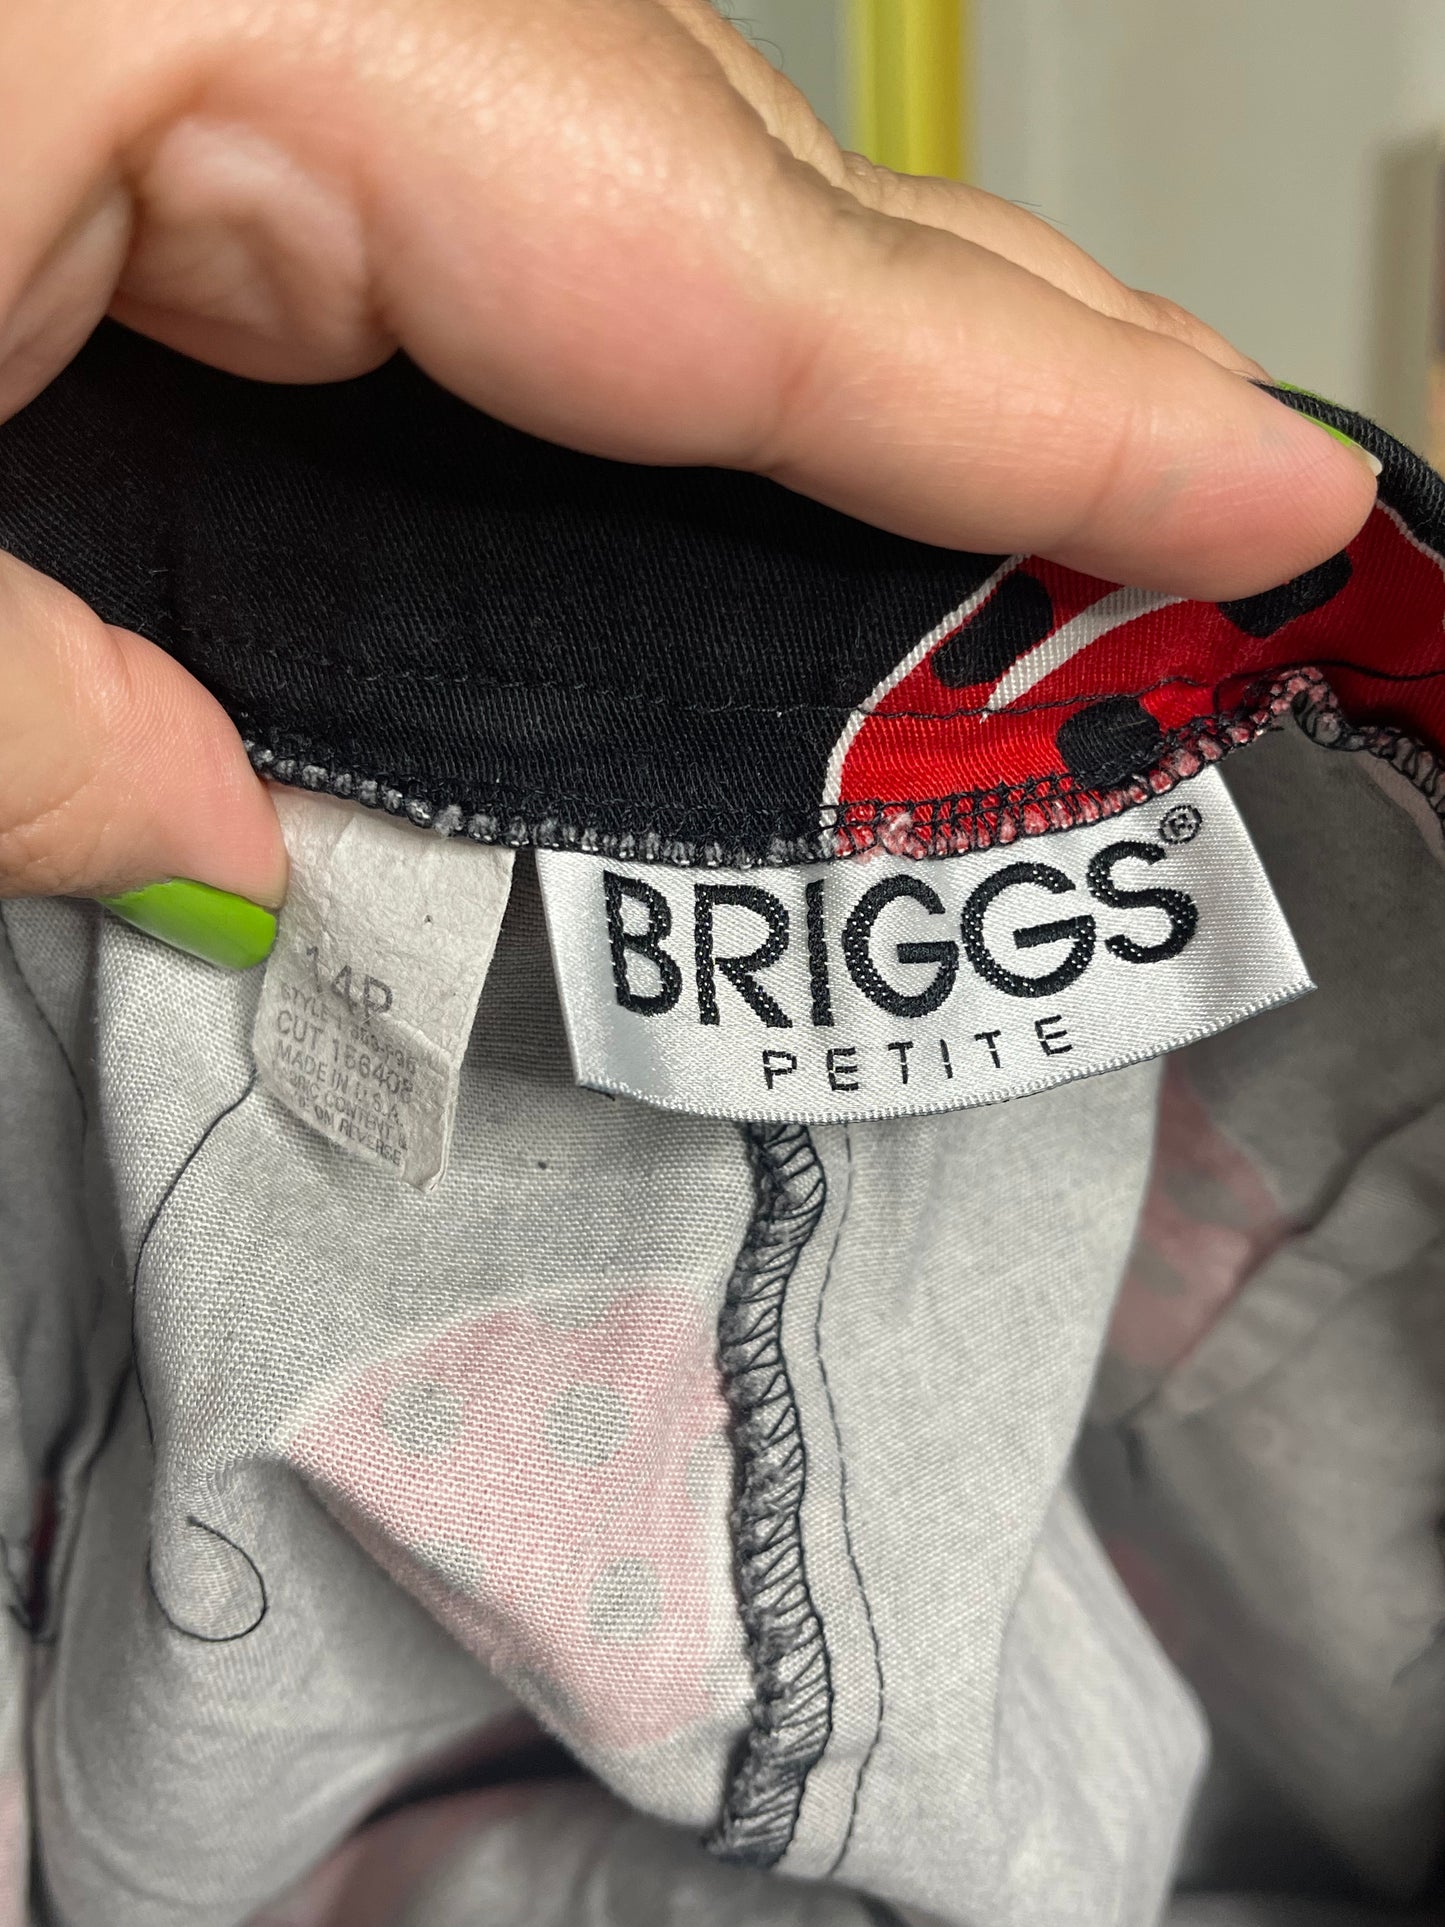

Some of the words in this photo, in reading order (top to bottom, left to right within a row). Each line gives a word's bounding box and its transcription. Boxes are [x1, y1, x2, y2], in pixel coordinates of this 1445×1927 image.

[306, 945, 394, 1026] 14P
[277, 1010, 325, 1051] CUT
[762, 1014, 1074, 1091] PETITE
[276, 1039, 328, 1083] MADE
[331, 1068, 349, 1094] IN
[314, 1103, 336, 1131] ON
[338, 1117, 403, 1166] REVERSE
[325, 1090, 394, 1142] CONTENT
